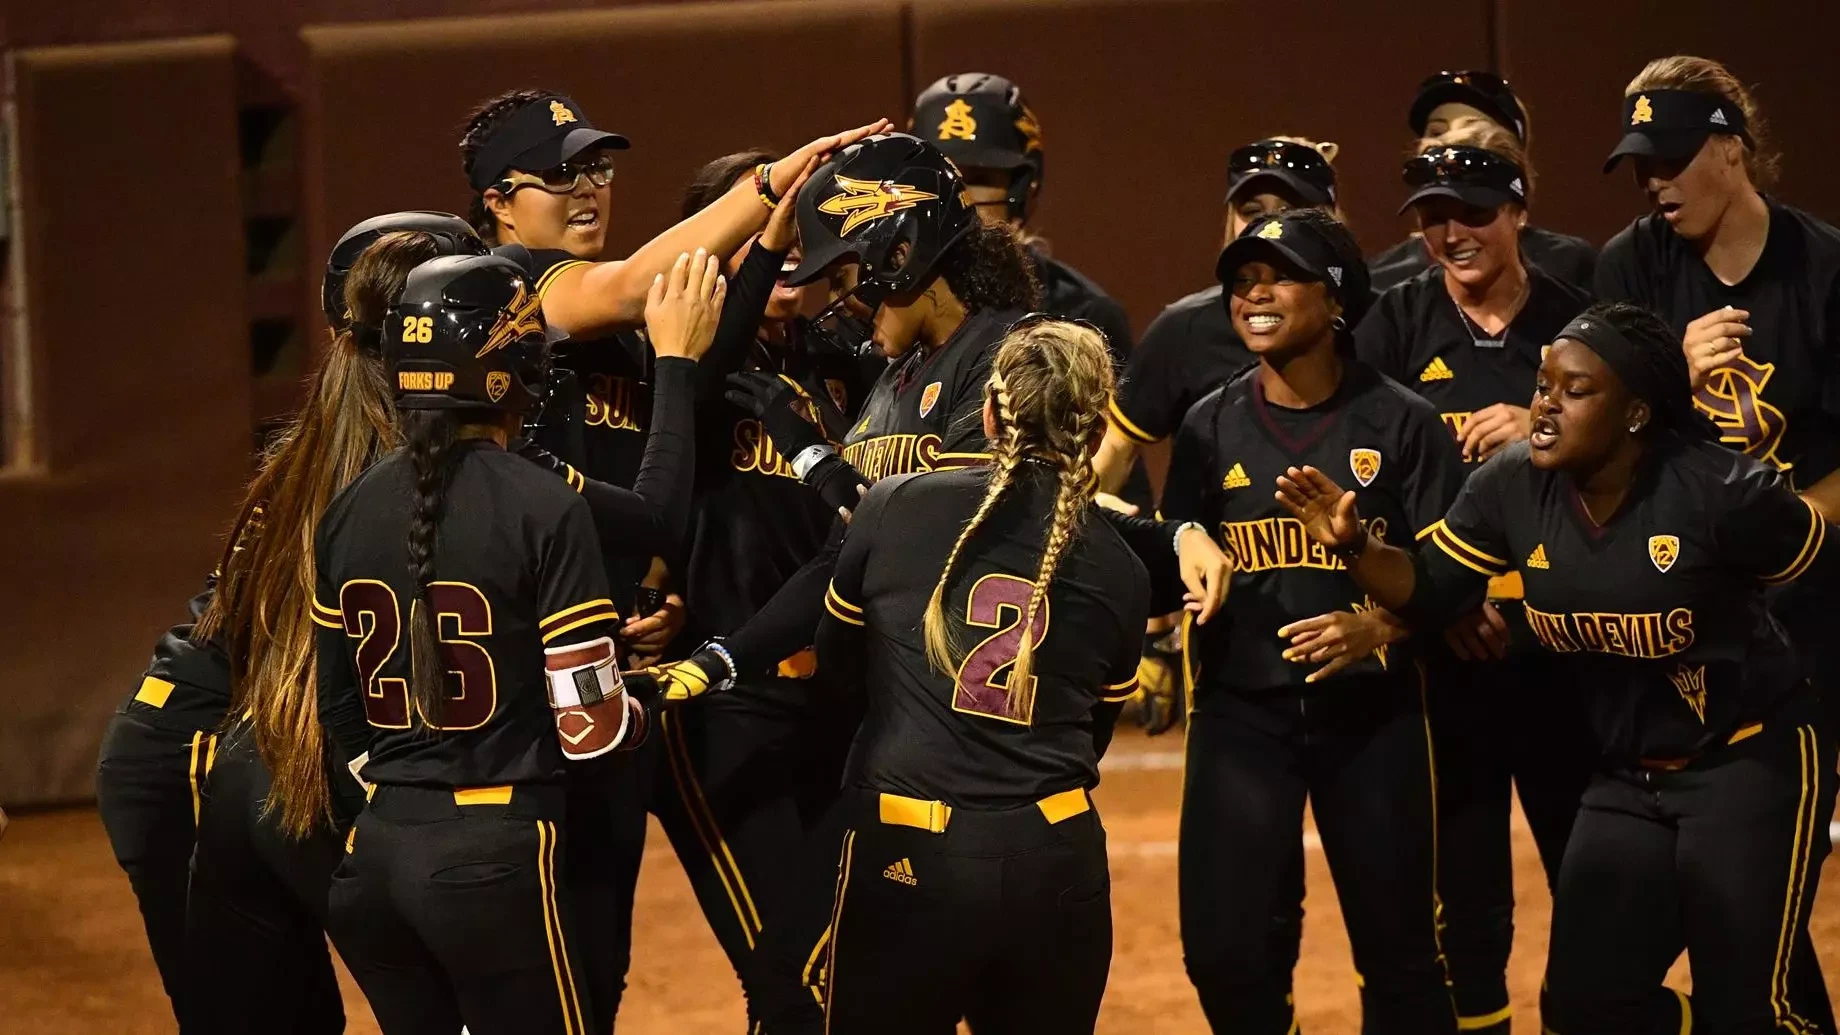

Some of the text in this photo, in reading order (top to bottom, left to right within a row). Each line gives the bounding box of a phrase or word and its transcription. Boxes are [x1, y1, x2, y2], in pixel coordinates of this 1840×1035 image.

[402, 315, 433, 344] 26
[398, 371, 455, 391] FORKS UP
[952, 572, 1050, 727] 2
[1571, 607, 1696, 659] DEVILS
[340, 579, 497, 730] 26
[883, 869, 918, 886] adidas
